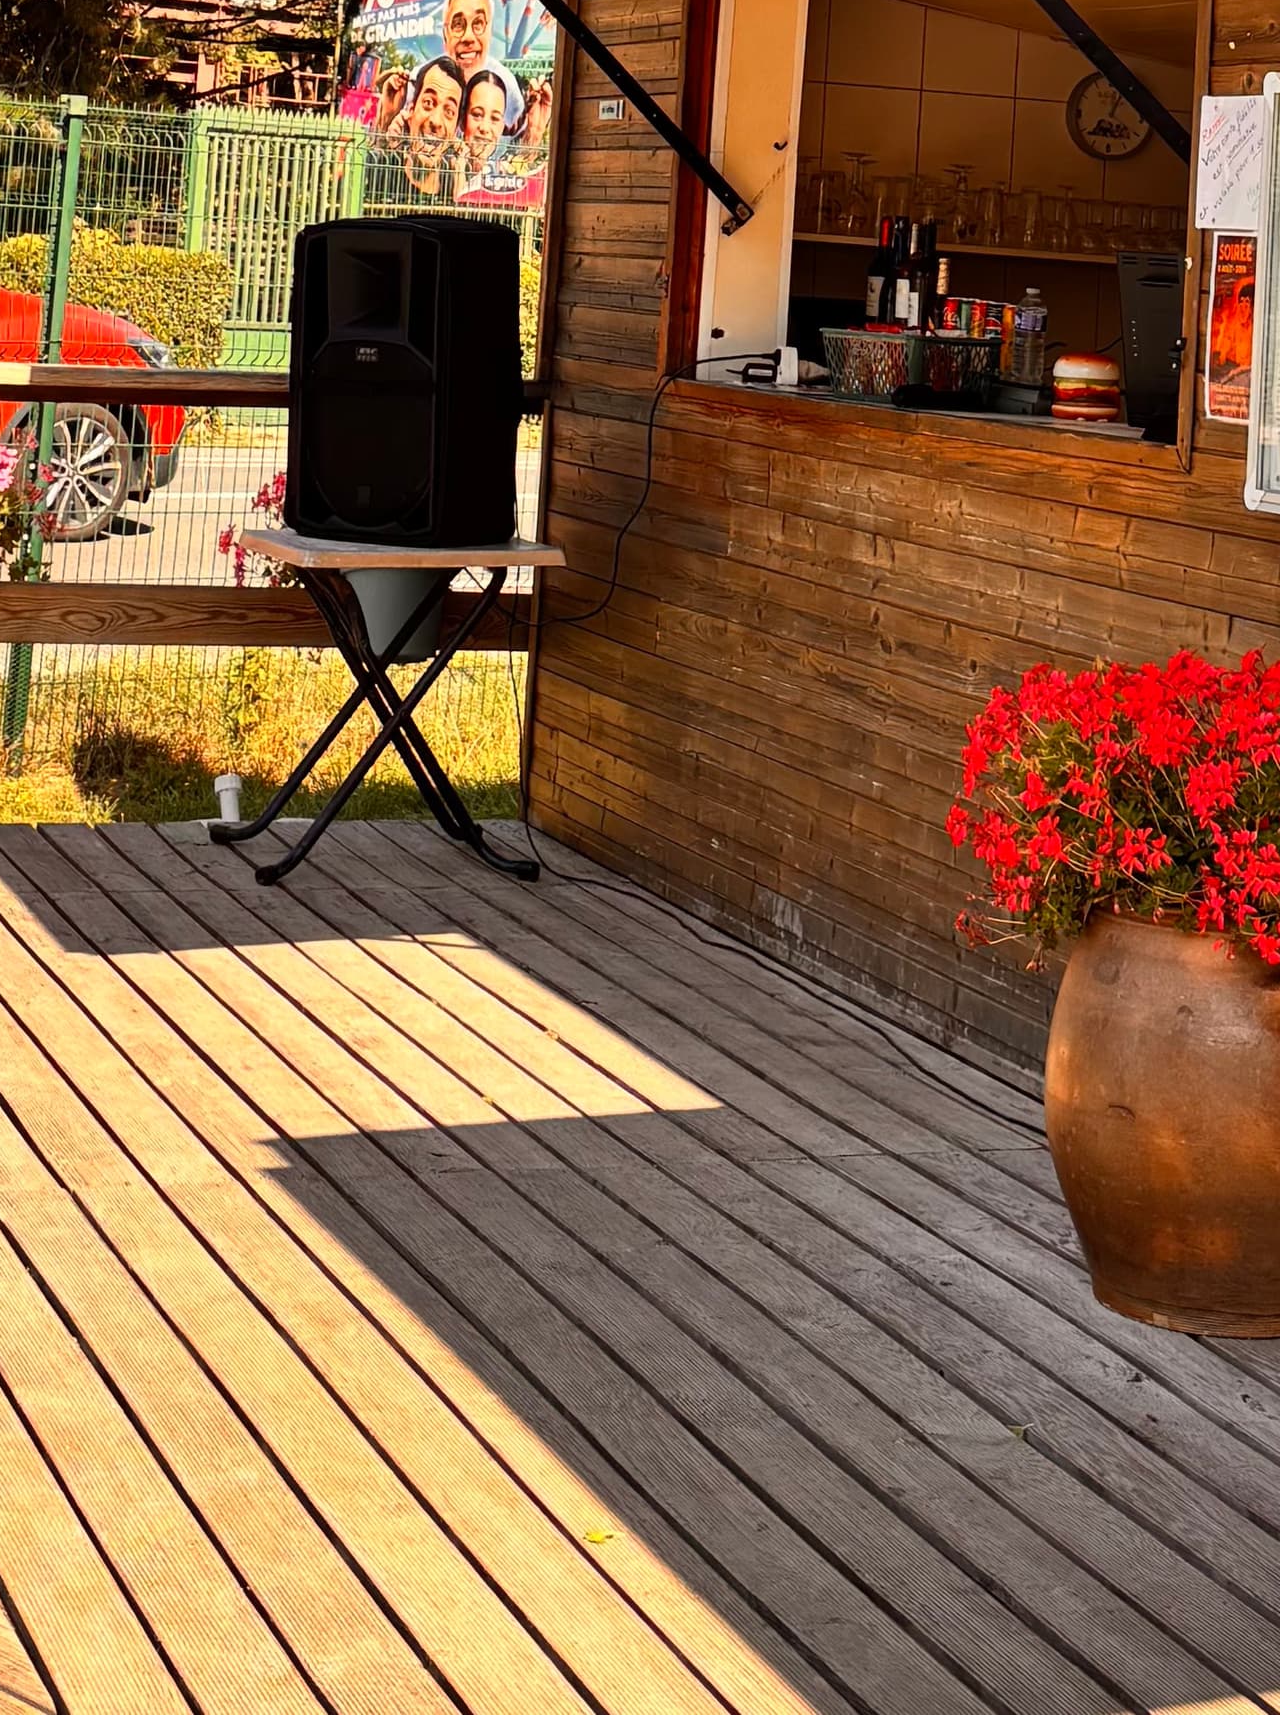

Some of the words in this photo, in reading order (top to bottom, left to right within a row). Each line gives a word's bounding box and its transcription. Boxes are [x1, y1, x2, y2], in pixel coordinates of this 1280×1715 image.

[350, 30, 364, 43] DE
[365, 15, 434, 43] GRANDIR
[353, 13, 376, 29] MAIS
[377, 8, 396, 23] PAS
